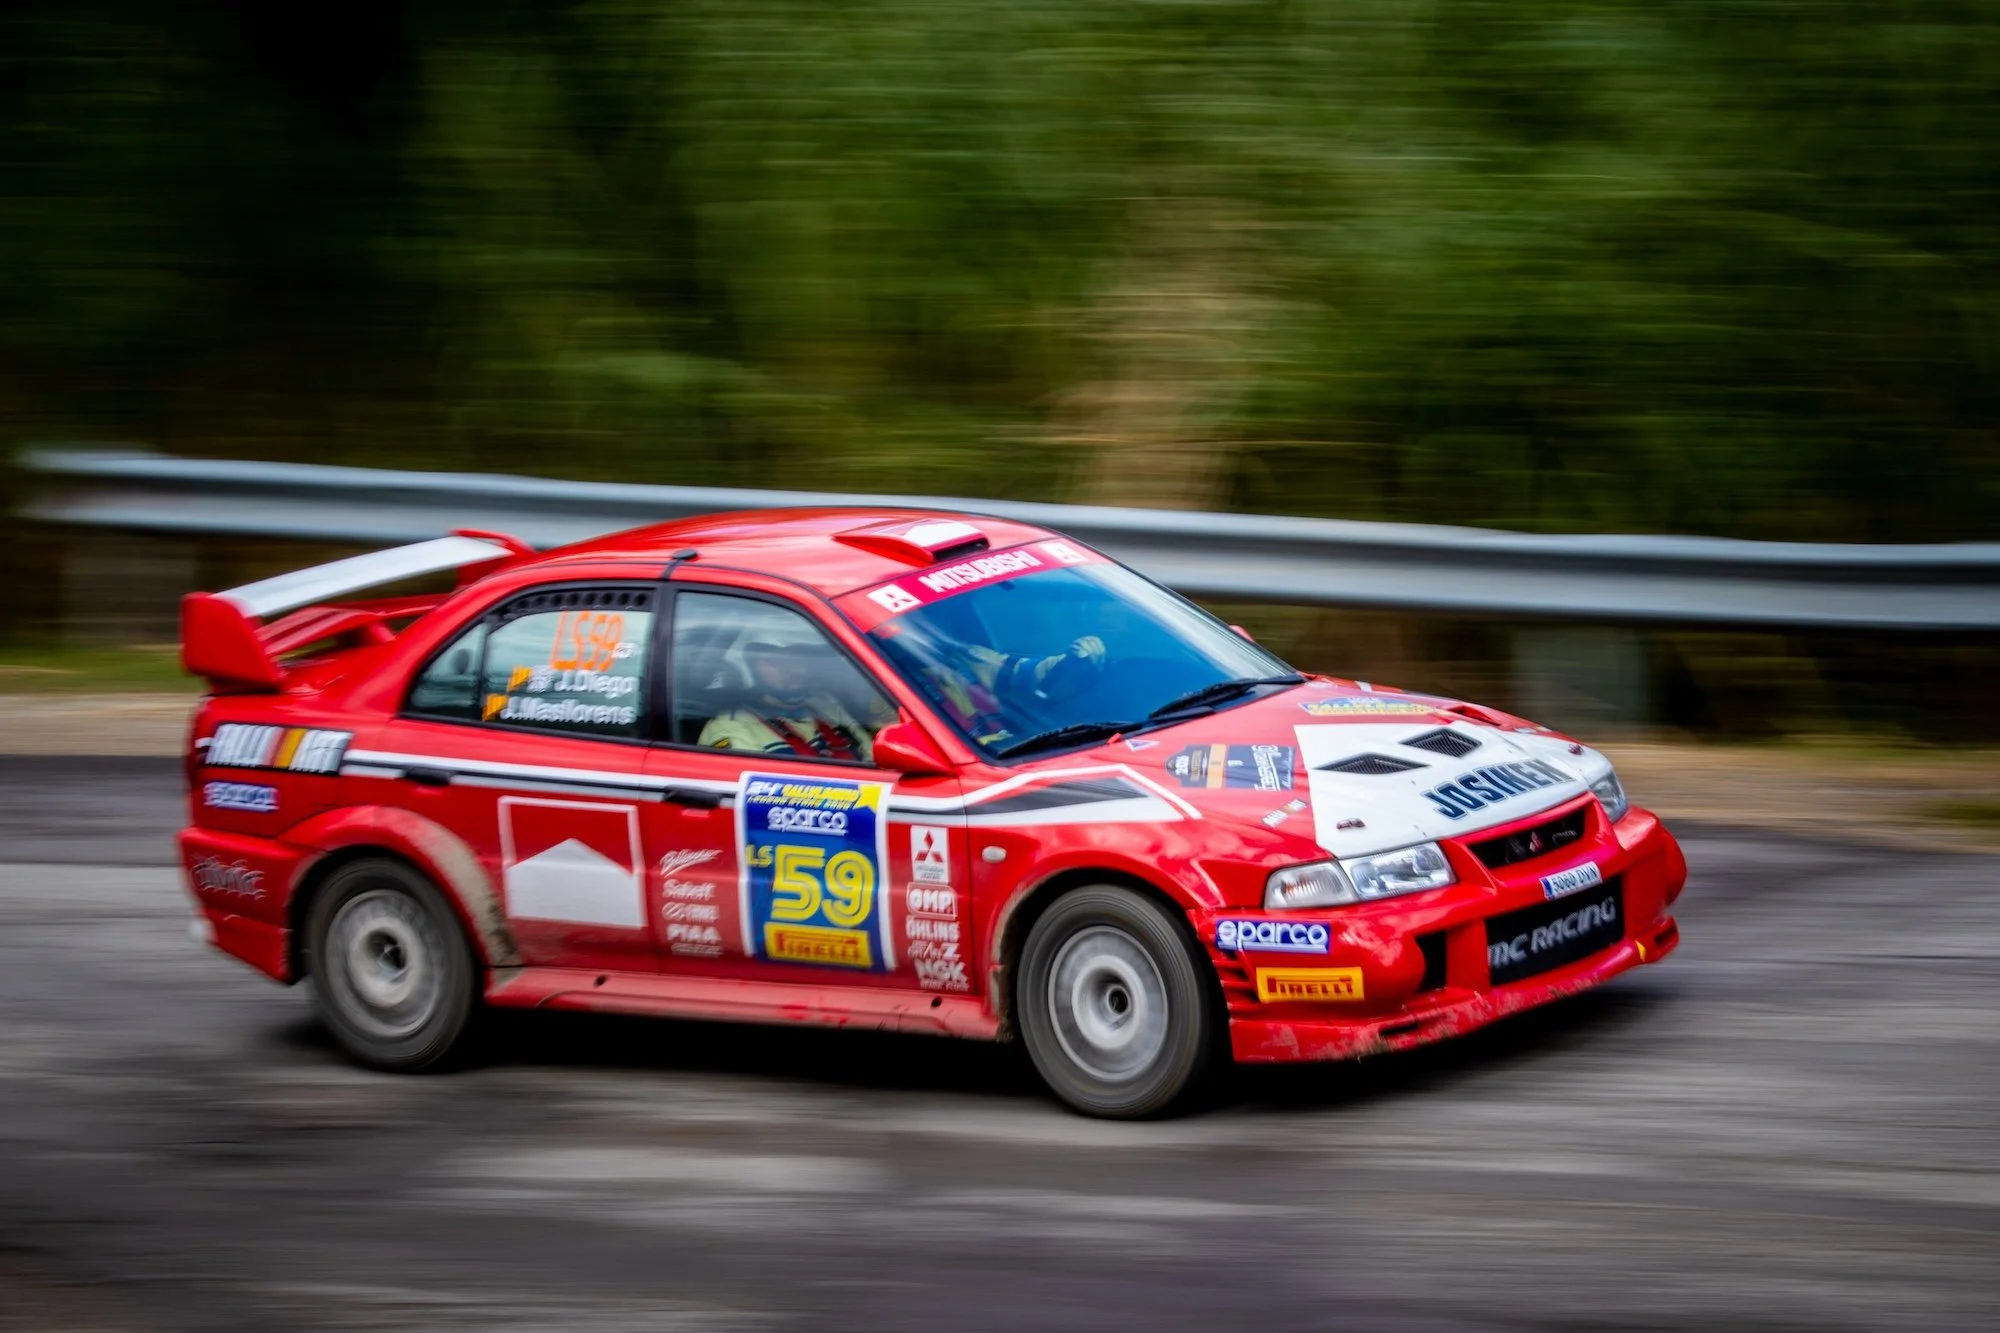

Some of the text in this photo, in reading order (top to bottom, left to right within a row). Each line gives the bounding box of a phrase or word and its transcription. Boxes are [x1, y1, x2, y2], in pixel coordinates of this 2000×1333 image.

[918, 550, 1044, 593] MITSUBISHI
[549, 609, 626, 673] LS59
[553, 669, 639, 699] J.Diego
[767, 806, 848, 836] sparco
[745, 844, 773, 868] LS
[770, 844, 875, 928] 59
[909, 889, 954, 913] OMP
[774, 930, 861, 961] PIRELLI
[1218, 920, 1329, 953] sparco
[1265, 974, 1353, 994] PIRELLI
